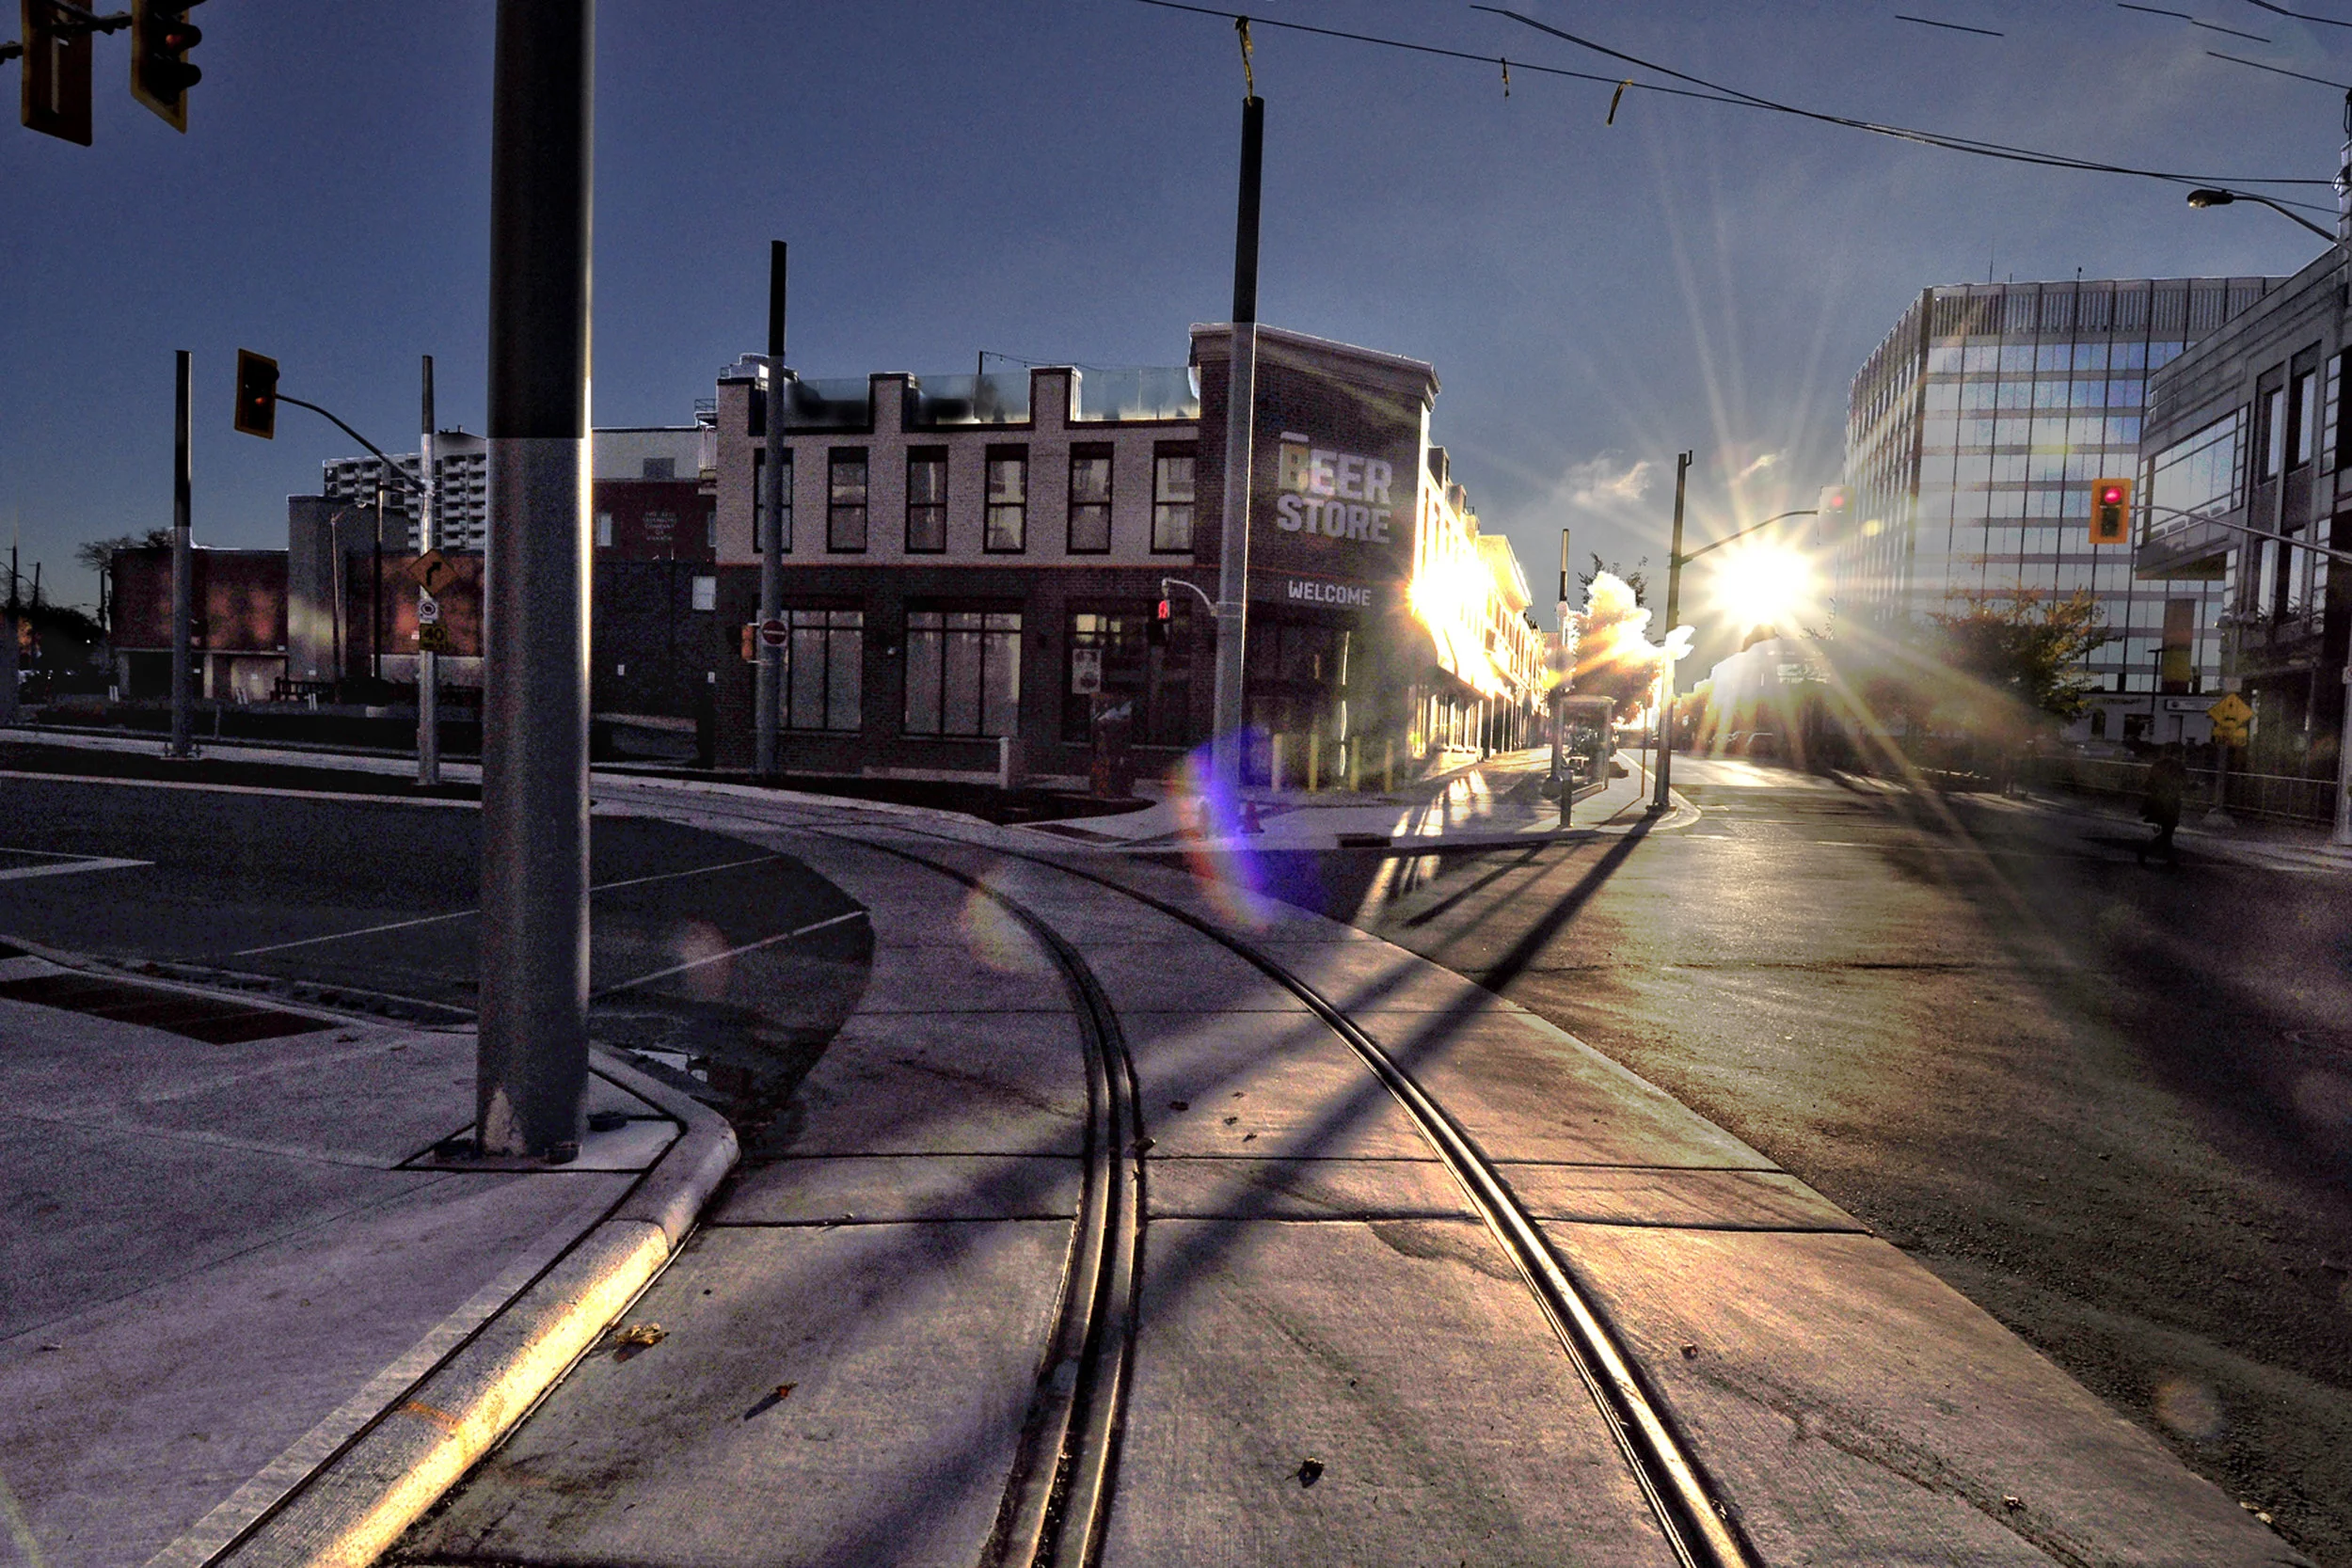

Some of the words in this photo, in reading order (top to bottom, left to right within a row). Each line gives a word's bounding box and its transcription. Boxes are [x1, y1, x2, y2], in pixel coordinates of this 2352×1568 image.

[1279, 432, 1393, 505] BEER
[1277, 494, 1391, 544] STORE
[1288, 579, 1372, 607] WELCOME
[424, 627, 444, 641] 40
